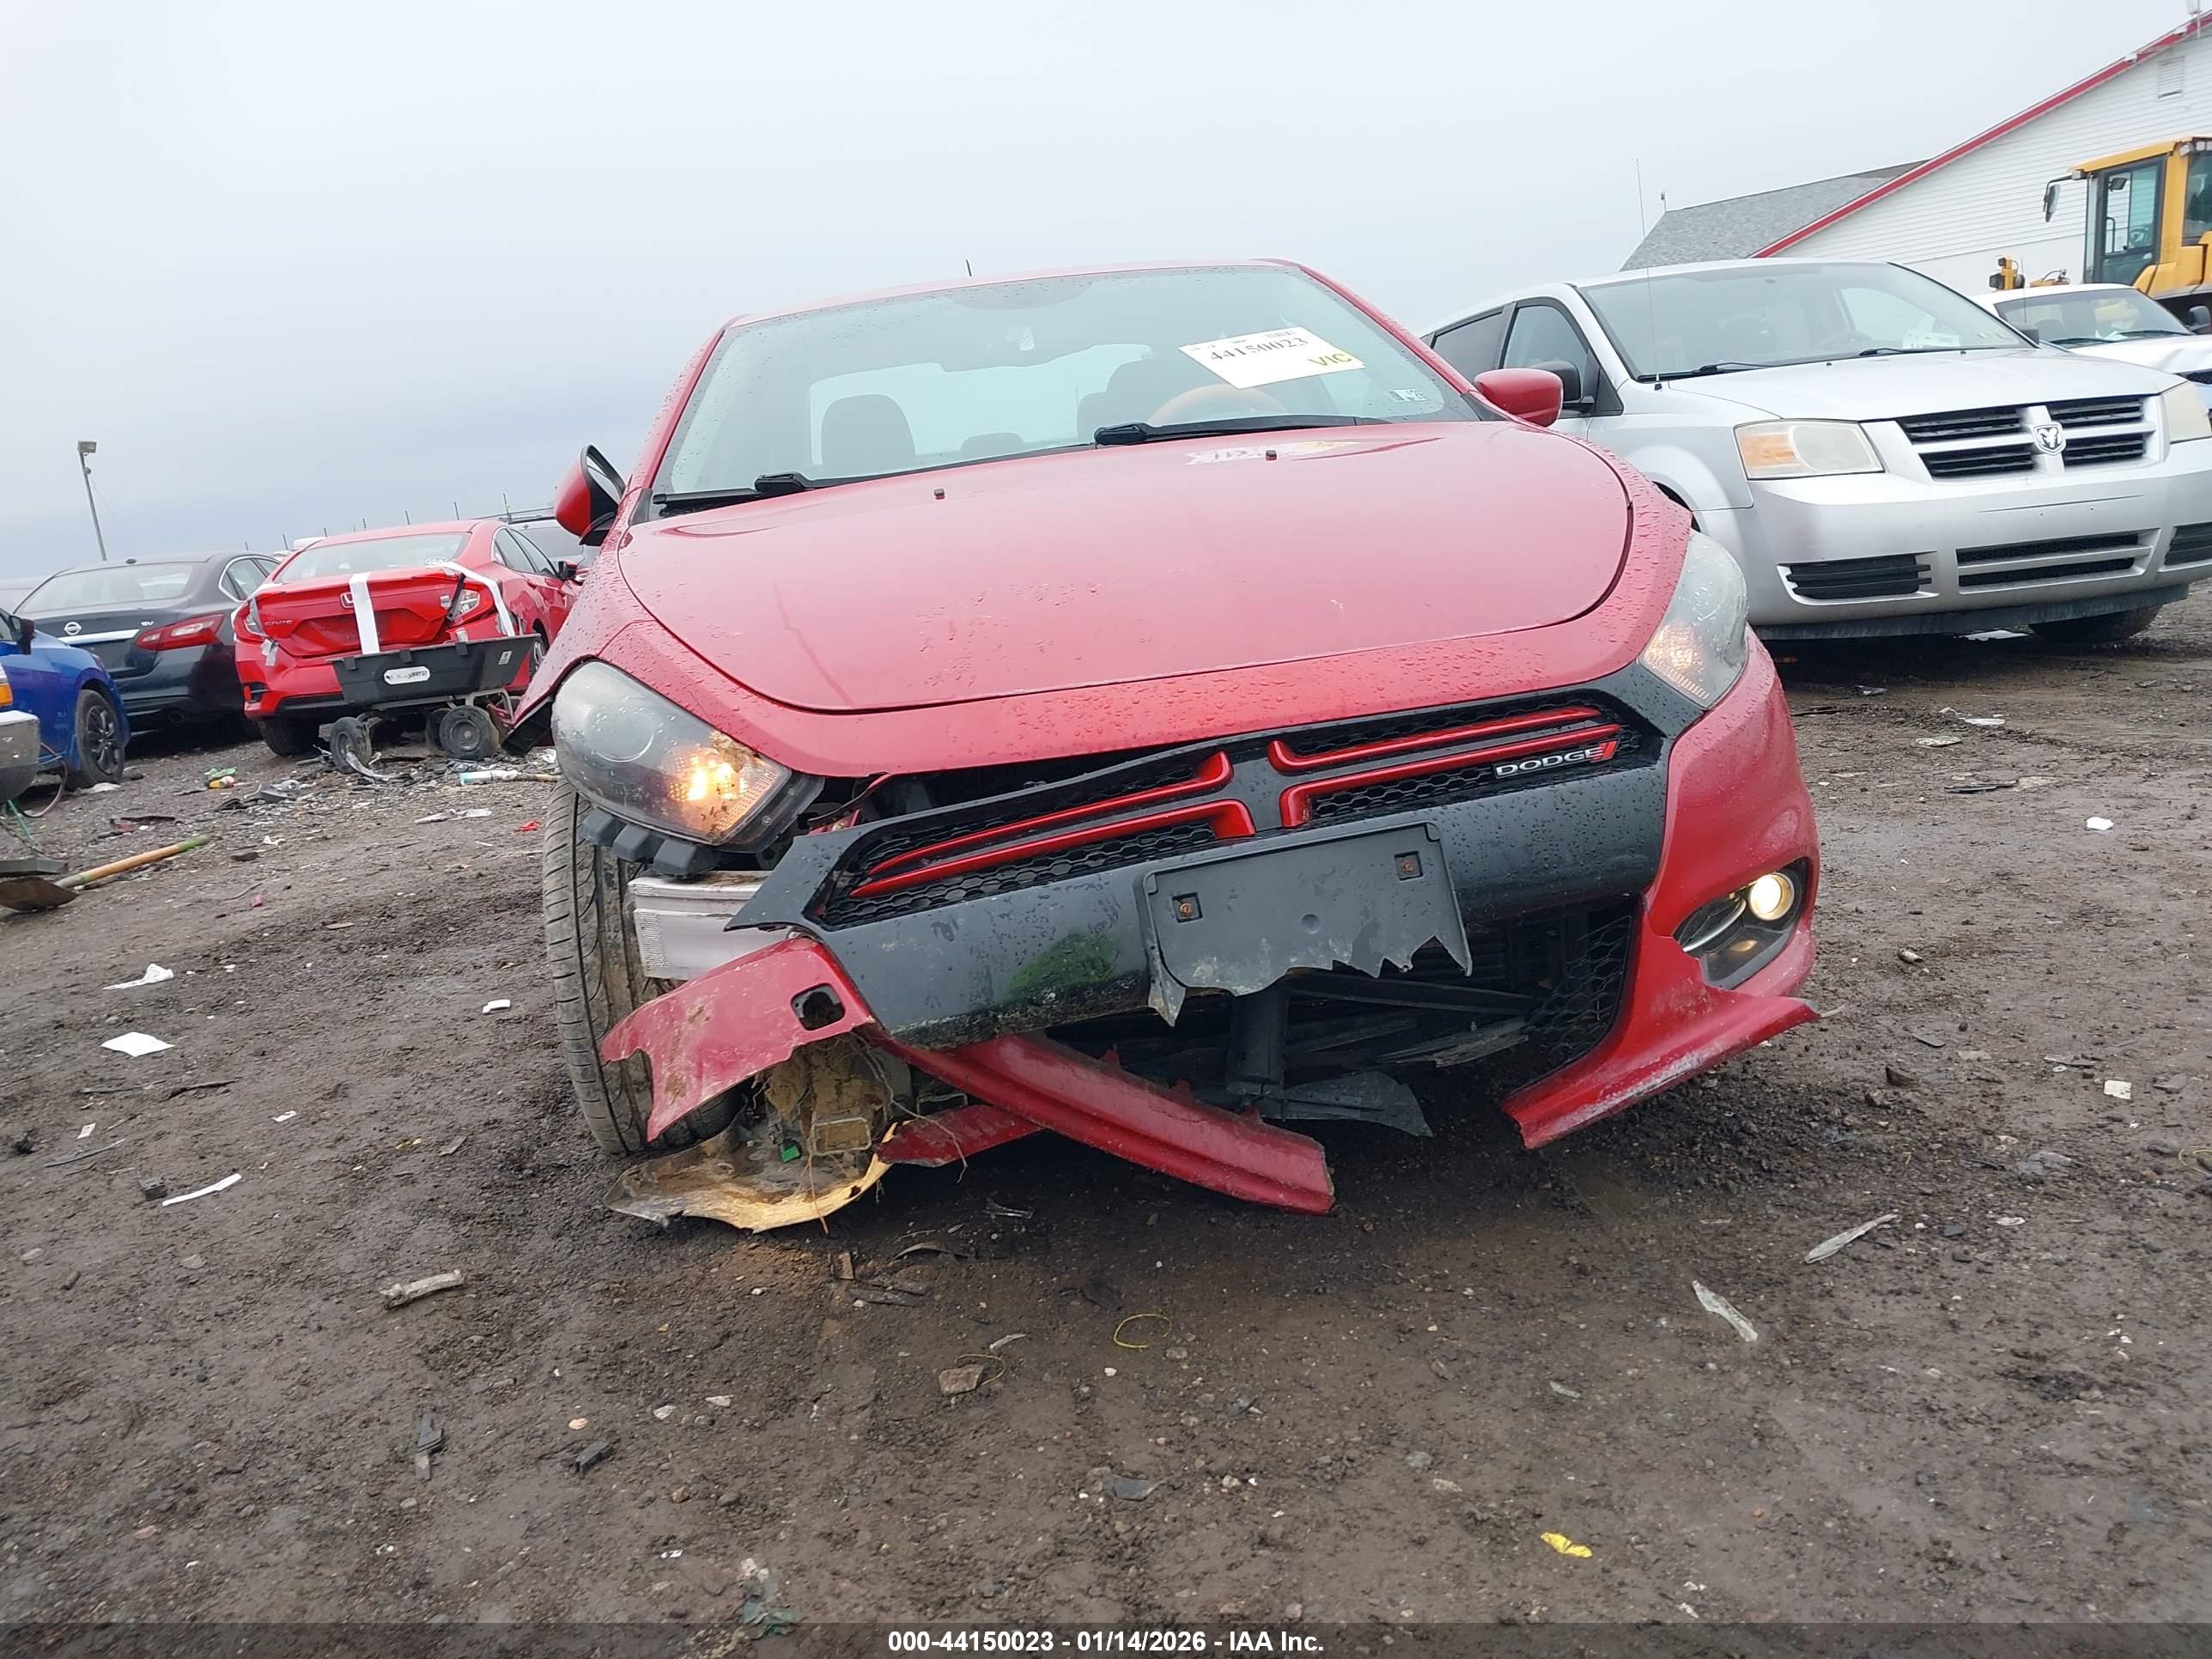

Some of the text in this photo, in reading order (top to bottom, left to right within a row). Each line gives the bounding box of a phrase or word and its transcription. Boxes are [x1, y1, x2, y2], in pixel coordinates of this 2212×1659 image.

[1210, 337, 1309, 361] 44150023
[1308, 353, 1352, 367] VIC
[1496, 745, 1604, 776] DODGE
